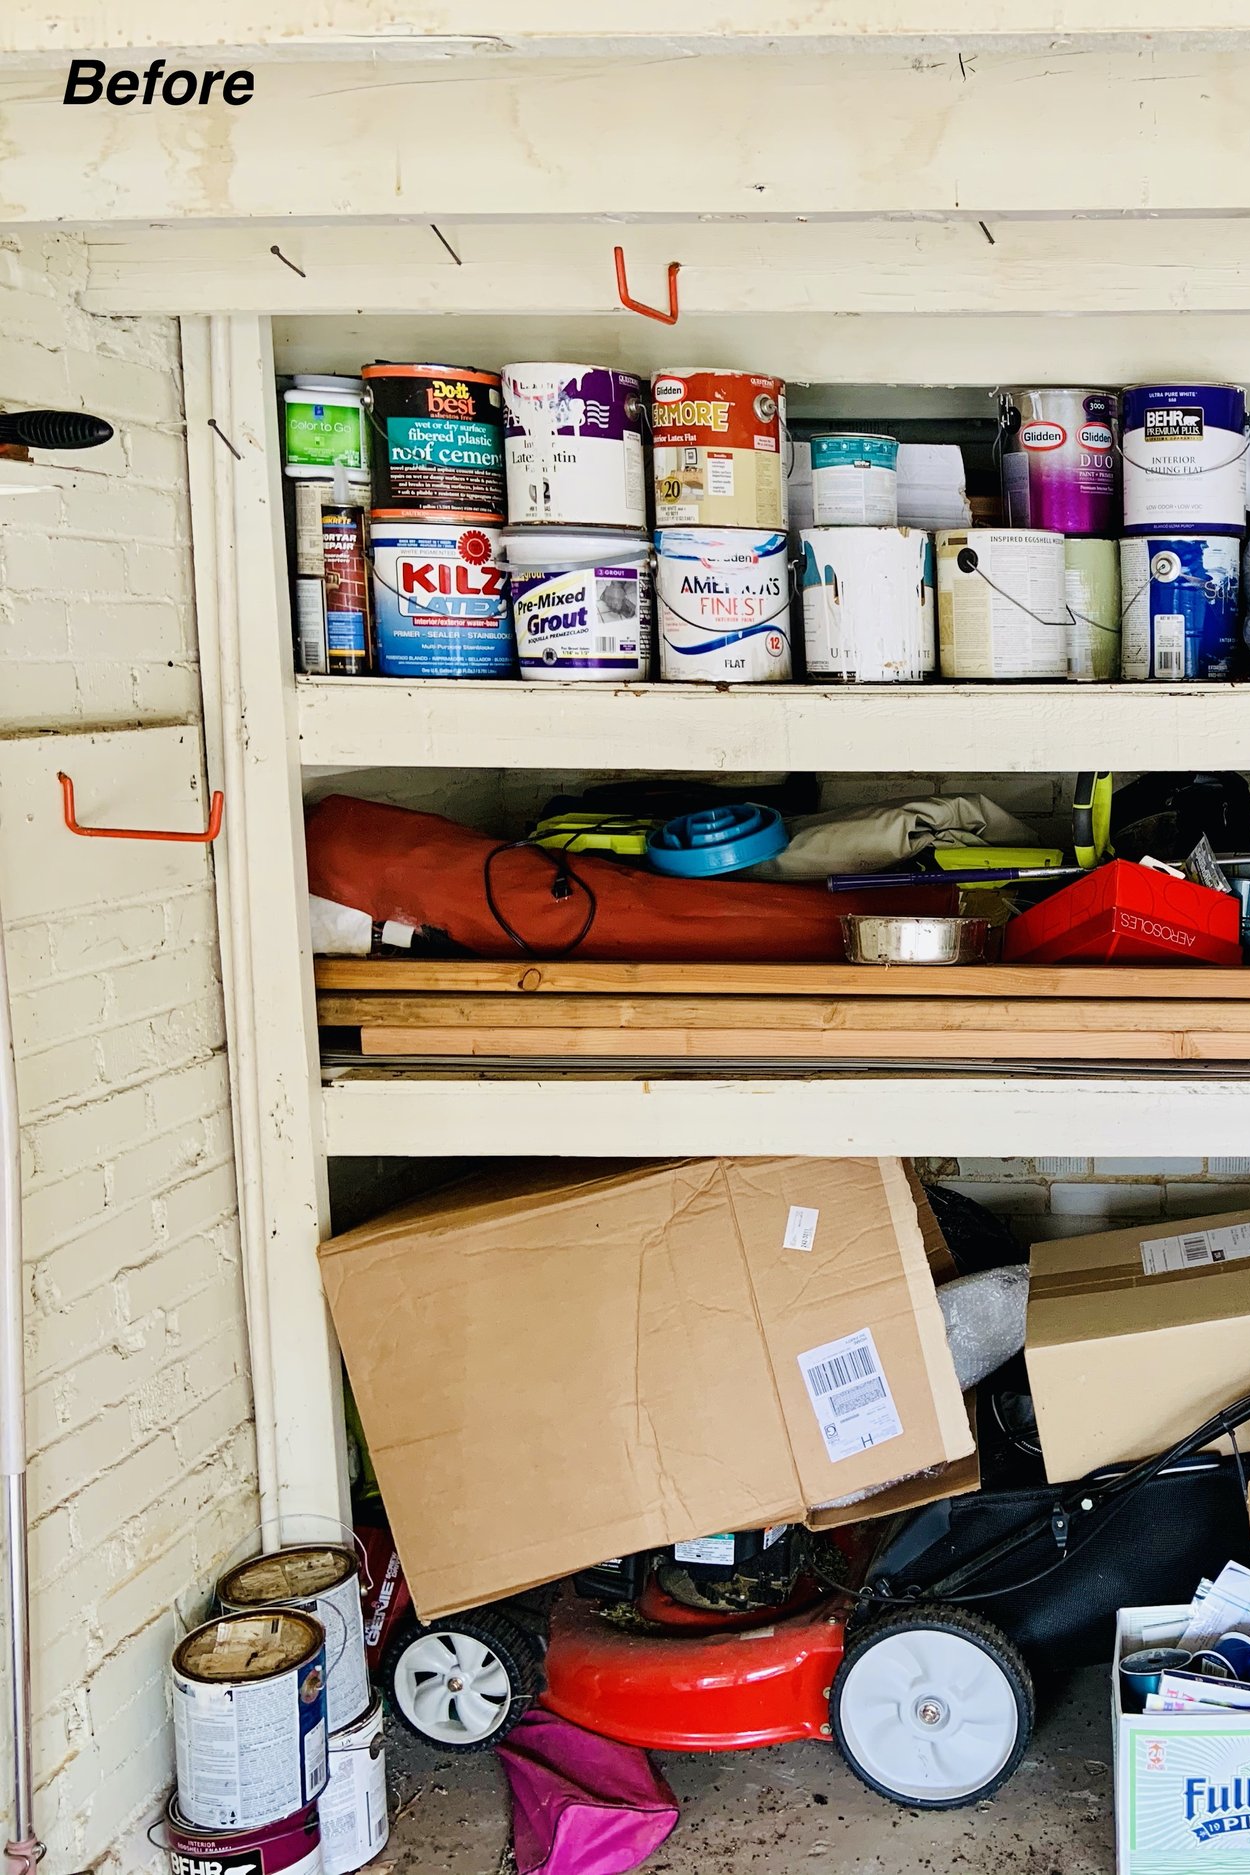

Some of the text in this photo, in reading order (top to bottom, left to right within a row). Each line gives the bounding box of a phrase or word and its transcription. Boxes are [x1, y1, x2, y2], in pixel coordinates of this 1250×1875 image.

[656, 387, 682, 395] Glidden
[426, 388, 476, 415] best
[1089, 402, 1105, 410] 3000
[652, 401, 729, 432] ERMORE
[1146, 410, 1183, 427] BEHR
[290, 420, 352, 433] Color to Go
[444, 421, 458, 431] dry
[460, 424, 486, 433] surface
[1147, 427, 1200, 436] PREMIUM PLUS
[408, 428, 492, 446] fibered plastic
[668, 434, 683, 442] Latex
[1024, 432, 1061, 442] Glidden
[1082, 432, 1111, 443] Glidden
[392, 442, 434, 461] roof
[1080, 453, 1113, 468] DUO
[1152, 456, 1196, 464] INTERIOR
[1145, 466, 1203, 474] CEILING FLAT
[664, 481, 680, 498] 20
[1025, 536, 1052, 544] EGGSHELL
[403, 563, 501, 595] KILZ
[518, 587, 586, 615] Pre-Mixed
[700, 598, 764, 616] FINEST
[527, 606, 588, 636] Grout
[770, 637, 780, 649] 12
[724, 660, 746, 668] FLAT
[1208, 1822, 1221, 1834] 19
[188, 1840, 216, 1848] INTERIOR
[170, 1852, 223, 1875] BEHR
